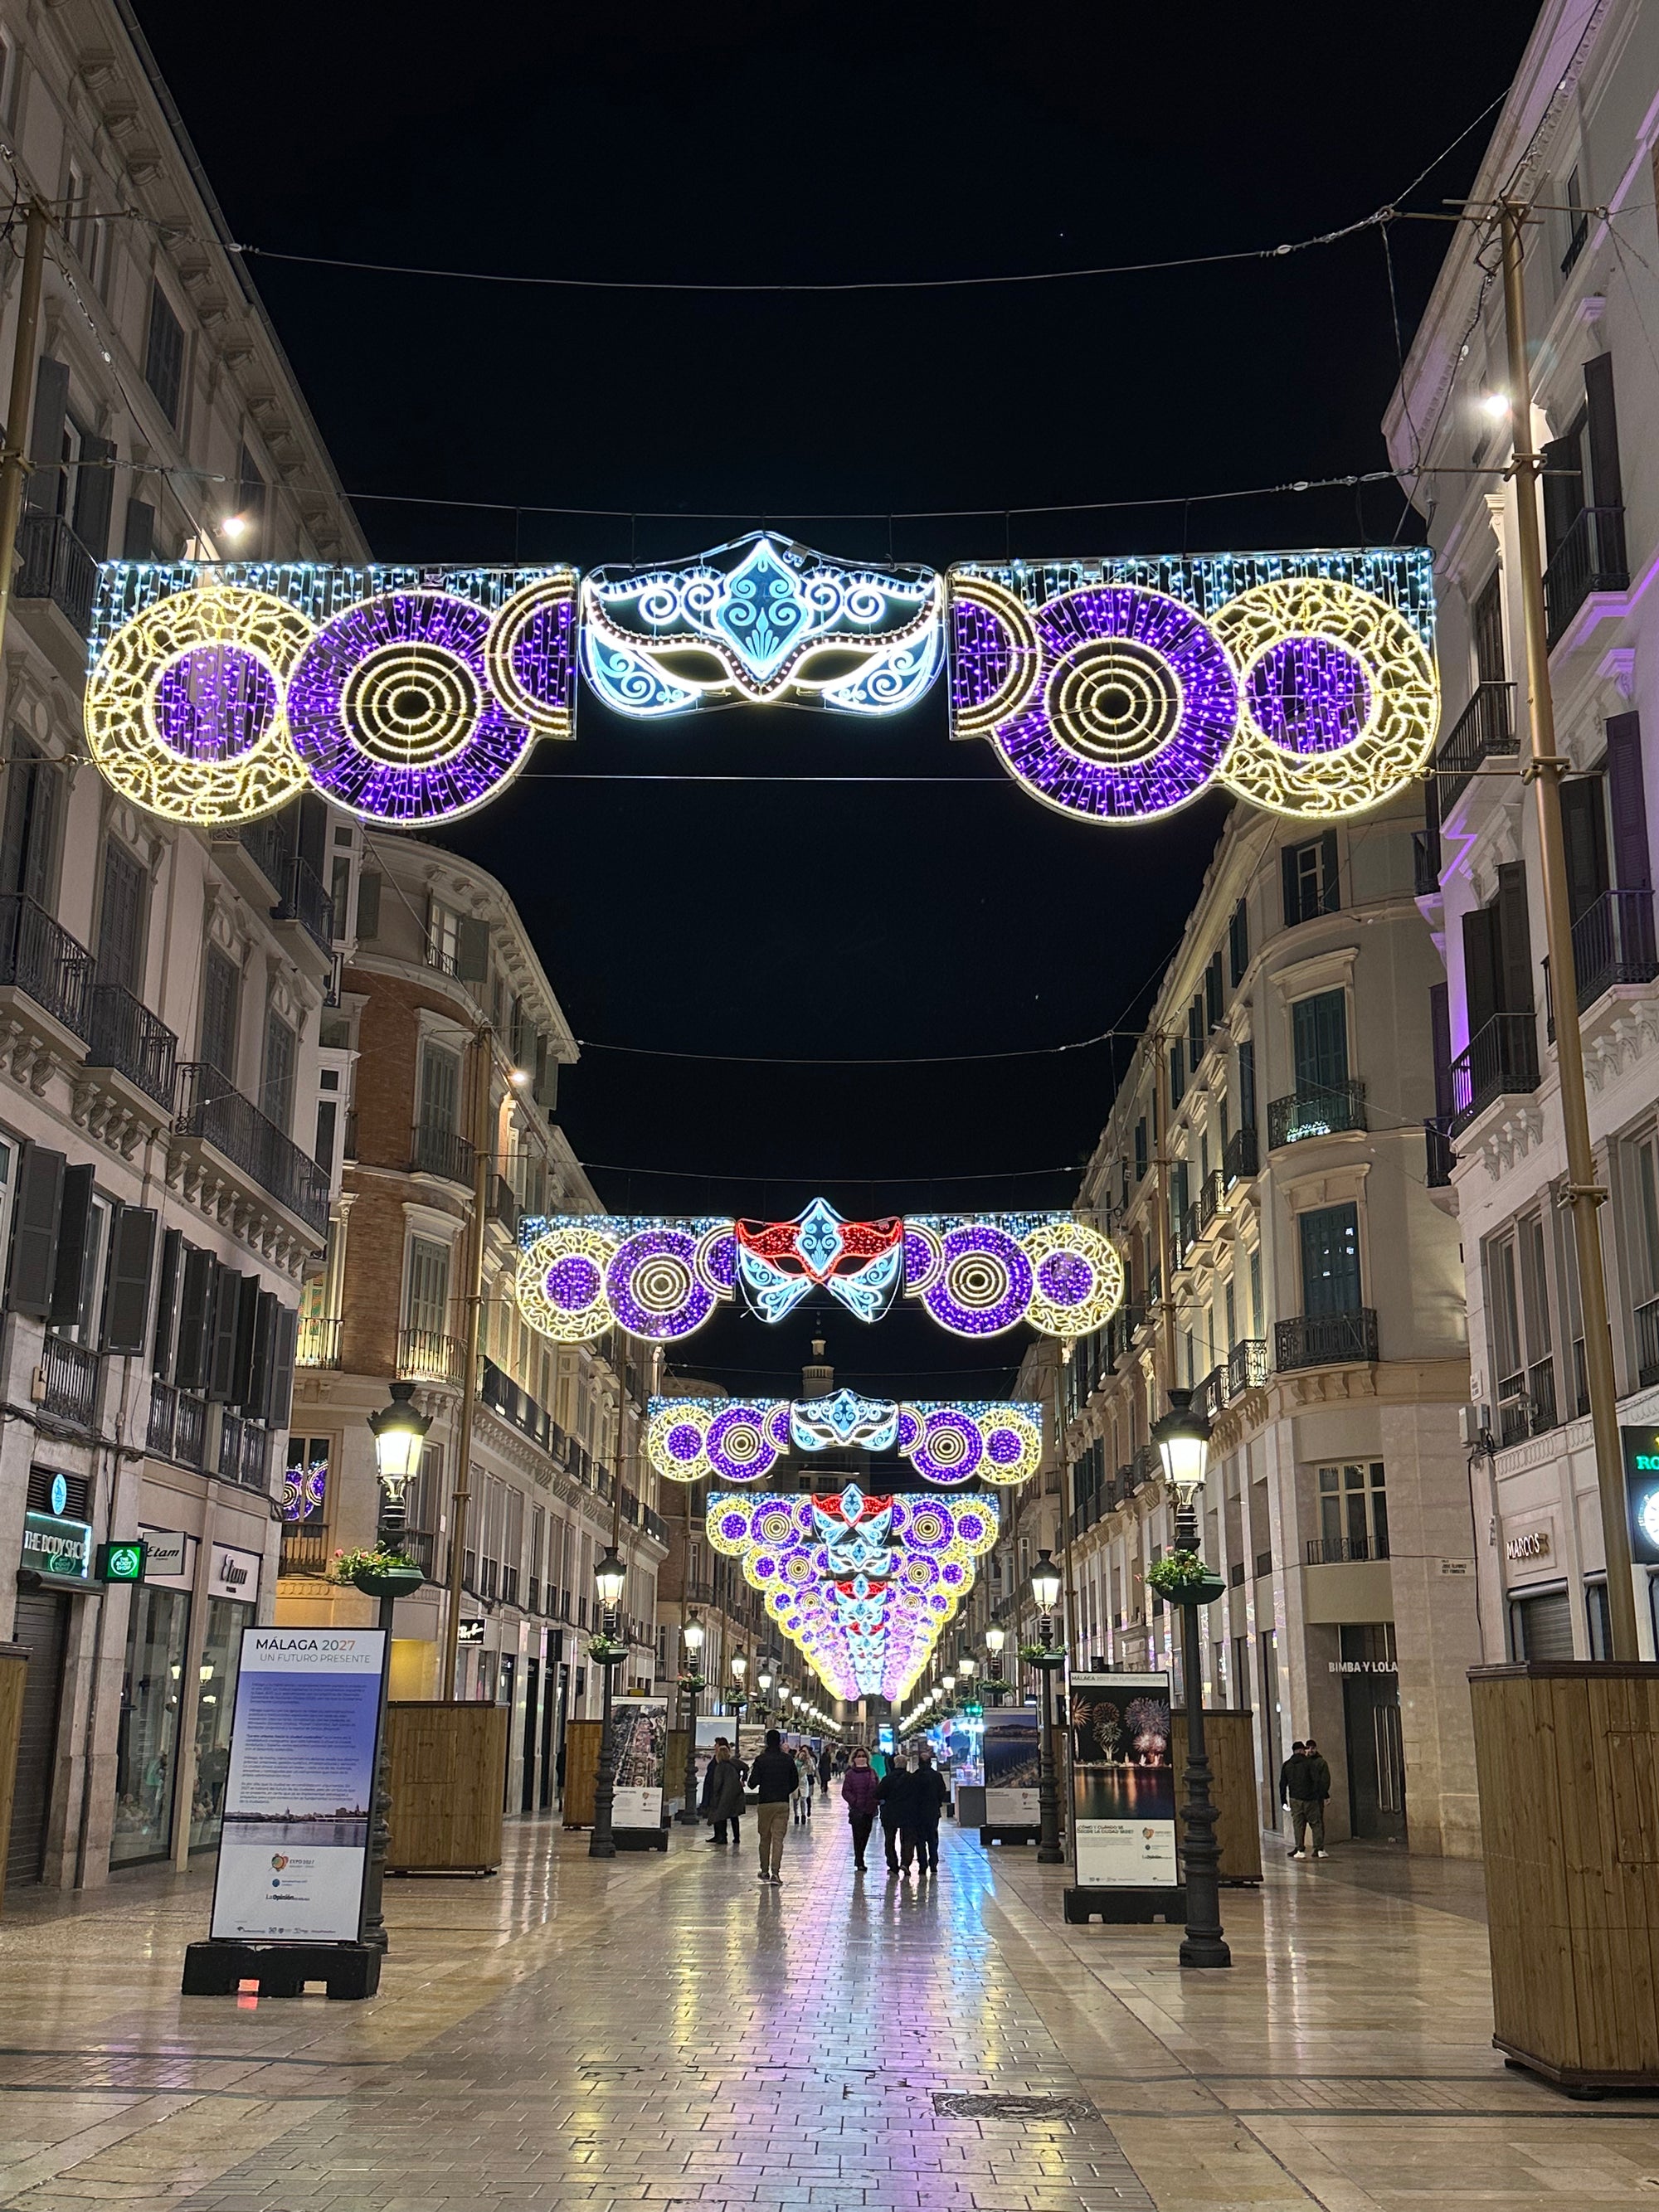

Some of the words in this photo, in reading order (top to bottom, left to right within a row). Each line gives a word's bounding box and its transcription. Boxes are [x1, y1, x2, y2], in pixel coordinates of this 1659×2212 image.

[24, 1530, 41, 1551] THE
[41, 1534, 66, 1555] BODY
[1506, 1533, 1540, 1559] MARCOS
[146, 1546, 180, 1558] Etam
[221, 1554, 248, 1585] Etam
[256, 1636, 318, 1650] MÁLAGA
[322, 1640, 356, 1651] 2027
[260, 1653, 275, 1662] UN
[277, 1654, 319, 1663] FUTURO
[320, 1654, 372, 1664] PRESENTE
[1329, 1661, 1361, 1673] BIMBA
[1363, 1661, 1370, 1672] Y
[1372, 1661, 1399, 1672] LOLA
